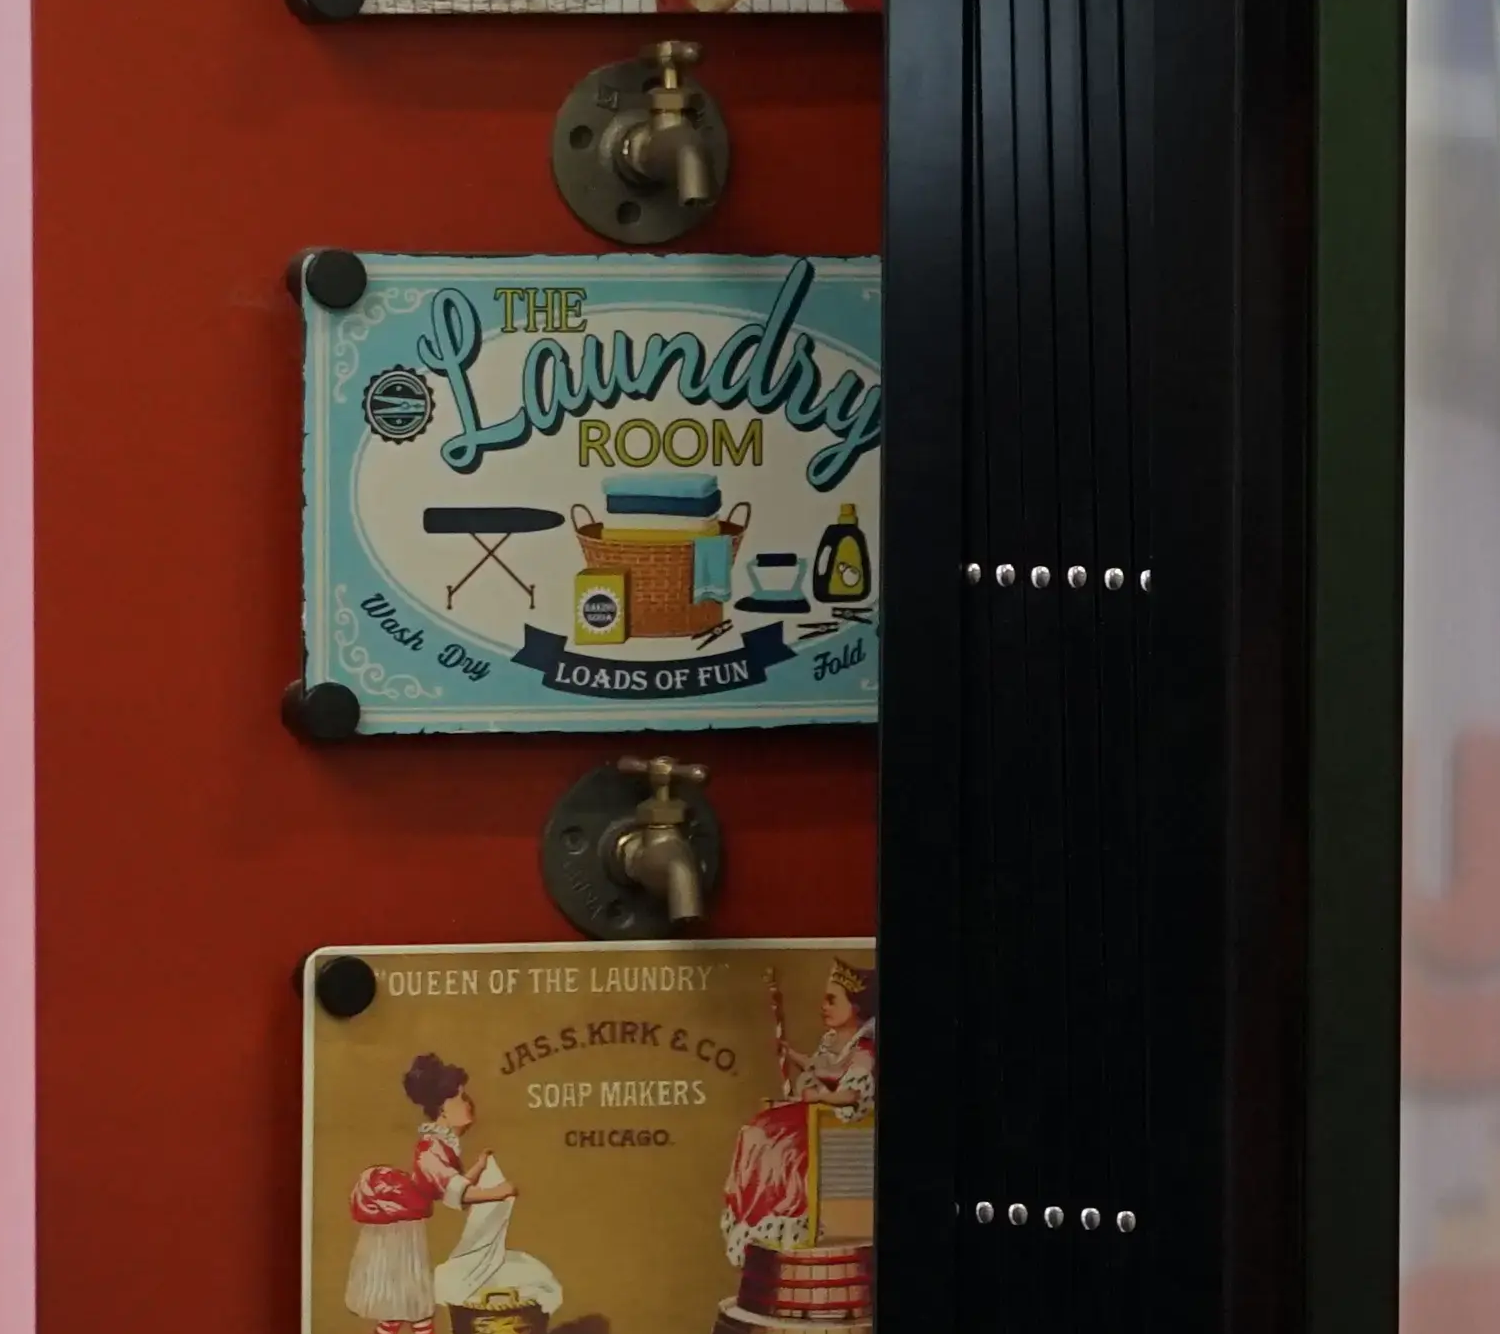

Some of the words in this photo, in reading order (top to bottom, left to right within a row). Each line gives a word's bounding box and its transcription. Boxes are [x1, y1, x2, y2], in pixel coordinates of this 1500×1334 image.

[493, 287, 588, 333] THE
[416, 257, 882, 492] Laundry
[577, 417, 765, 467] ROOM
[359, 592, 426, 653] Wash
[554, 661, 649, 691] LOADS
[654, 665, 692, 690] OF
[697, 660, 751, 687] FUN
[488, 967, 522, 995] OF
[528, 966, 579, 994] THE
[527, 1082, 593, 1109] SOAP
[600, 1080, 707, 1107] MAKERS
